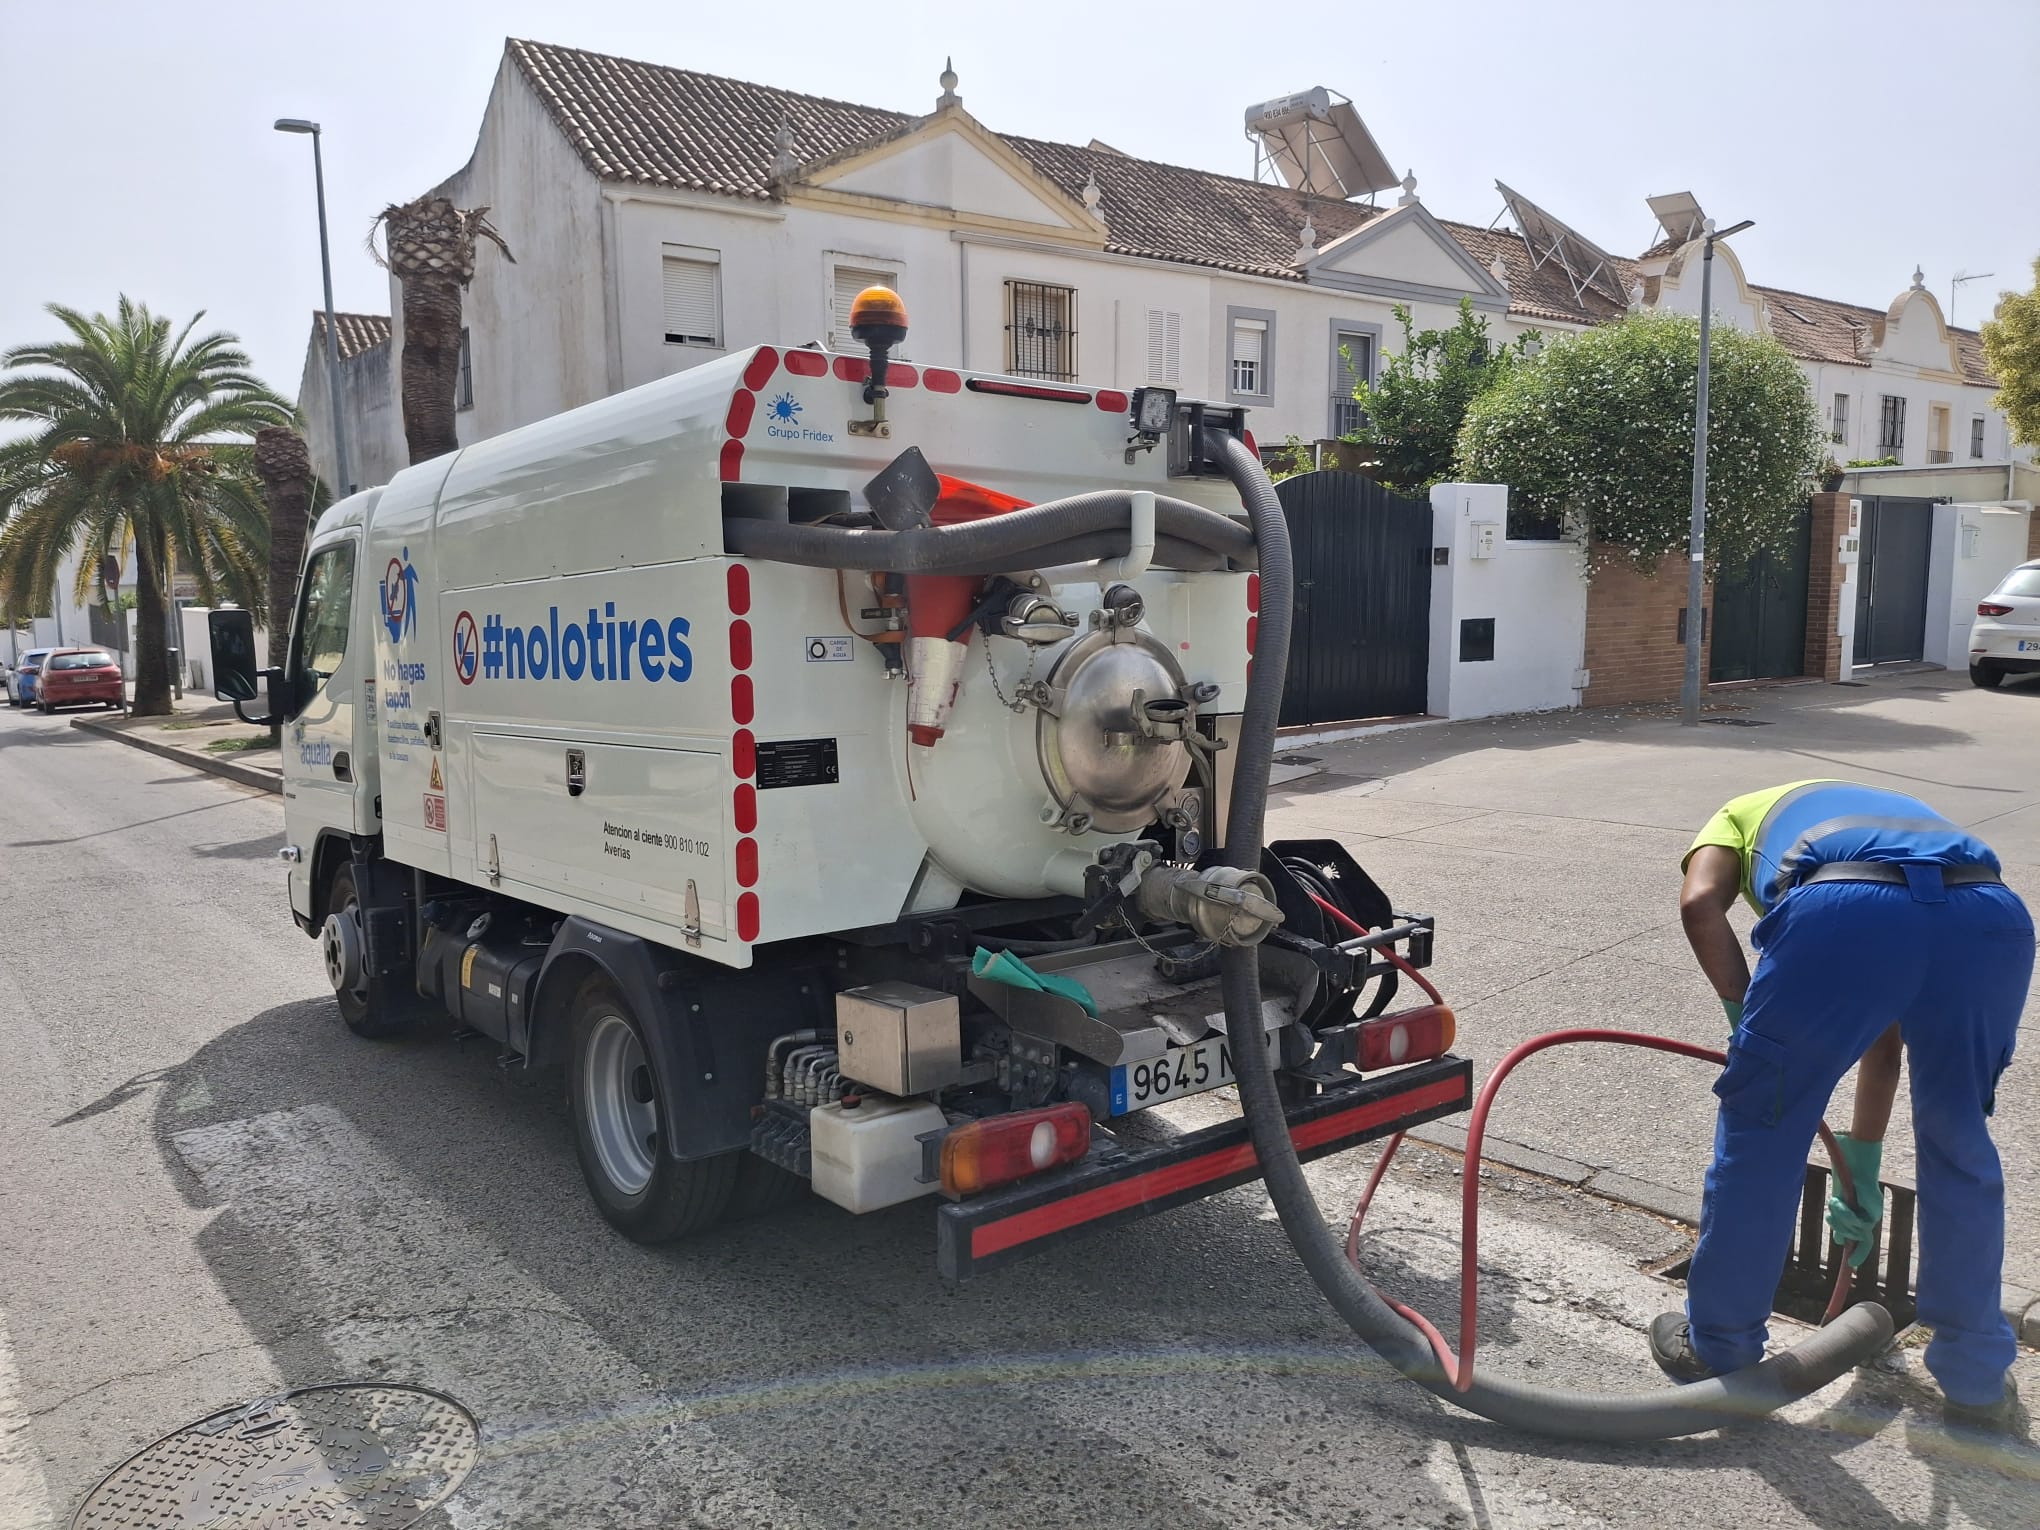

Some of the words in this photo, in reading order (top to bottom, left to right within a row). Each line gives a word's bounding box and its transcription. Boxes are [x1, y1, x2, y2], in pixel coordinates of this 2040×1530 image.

[767, 425, 800, 440] Grupo
[802, 429, 834, 442] Fridex
[483, 602, 693, 683] #nolotires
[2026, 642, 2040, 651] 29
[384, 660, 396, 680] No
[397, 659, 426, 685] hagas
[385, 686, 411, 712] tapón
[301, 736, 331, 773] aqualia
[603, 821, 632, 840] Atencion
[633, 828, 640, 841] al
[664, 834, 678, 850] 900
[679, 837, 694, 854] 810
[695, 840, 710, 857] 102
[604, 841, 631, 860] Averias
[1133, 1048, 1210, 1101] 9645
[1115, 1094, 1123, 1105] E
